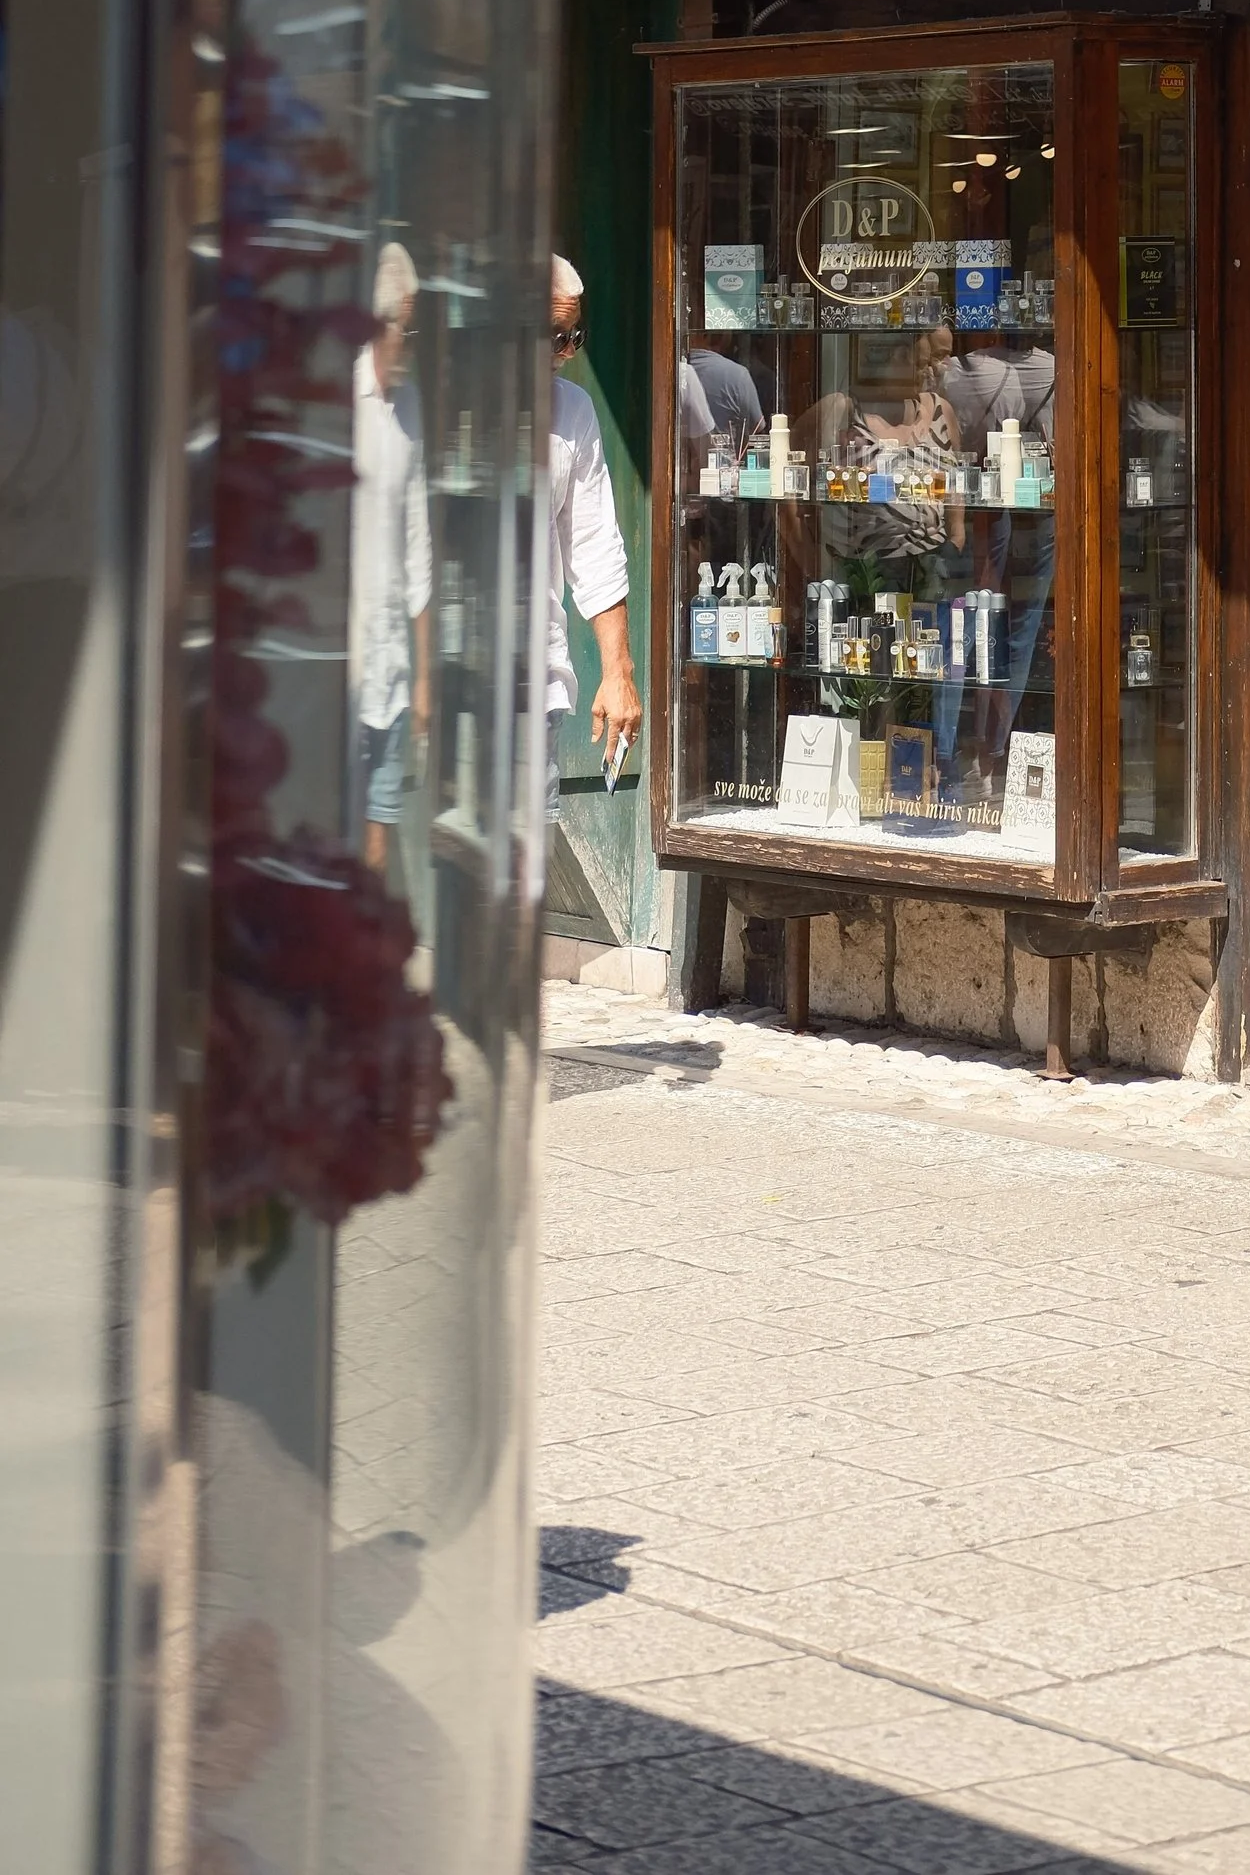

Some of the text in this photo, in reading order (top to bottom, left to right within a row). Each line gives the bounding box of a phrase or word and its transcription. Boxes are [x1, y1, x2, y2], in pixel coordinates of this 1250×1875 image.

[1161, 78, 1184, 87] ALARM
[817, 246, 914, 275] perfumum
[1140, 270, 1164, 280] BLACK
[714, 779, 734, 798] sve
[738, 778, 772, 803] može
[775, 781, 791, 803] da
[795, 787, 809, 804] se
[875, 792, 895, 815] ali
[899, 794, 922, 818] vaš
[925, 797, 963, 822] miris
